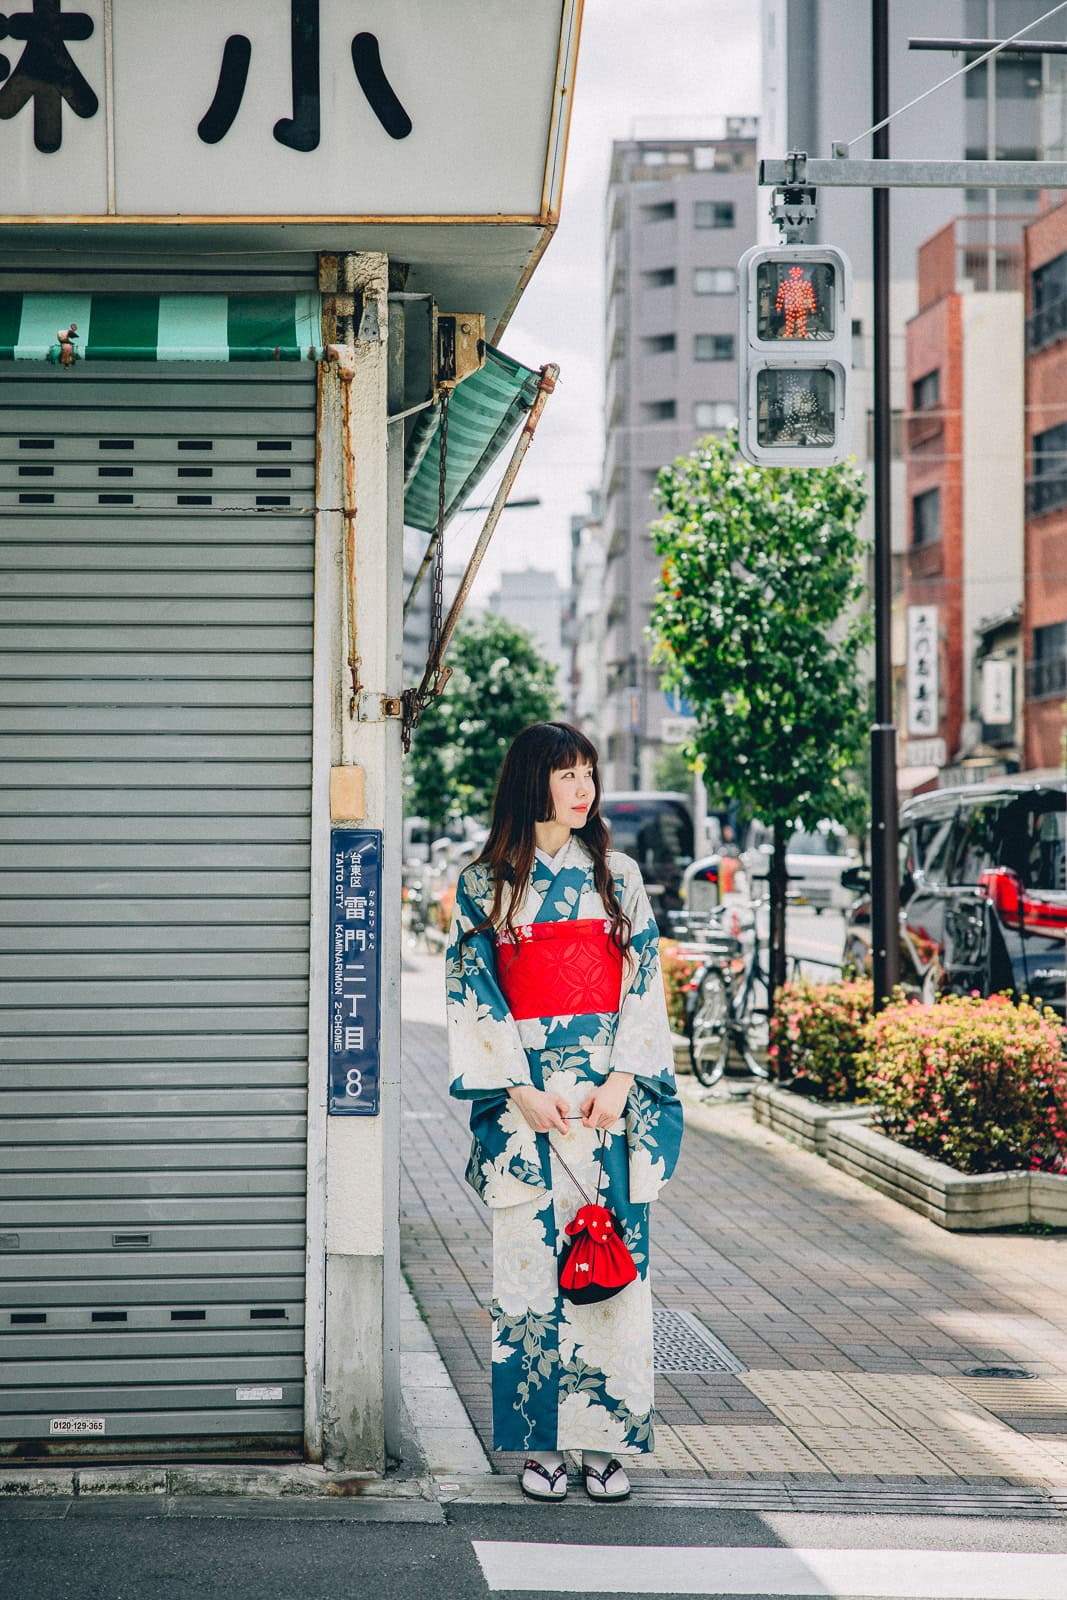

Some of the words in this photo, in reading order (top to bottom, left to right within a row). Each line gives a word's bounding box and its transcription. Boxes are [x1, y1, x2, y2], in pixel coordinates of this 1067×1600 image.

[335, 851, 344, 882] TAITO
[350, 852, 362, 888] 台東区
[335, 884, 344, 909] CITY
[334, 924, 344, 995] KAMINARIMON
[334, 1001, 343, 1050] 2-CHOME
[346, 1068, 362, 1097] 8
